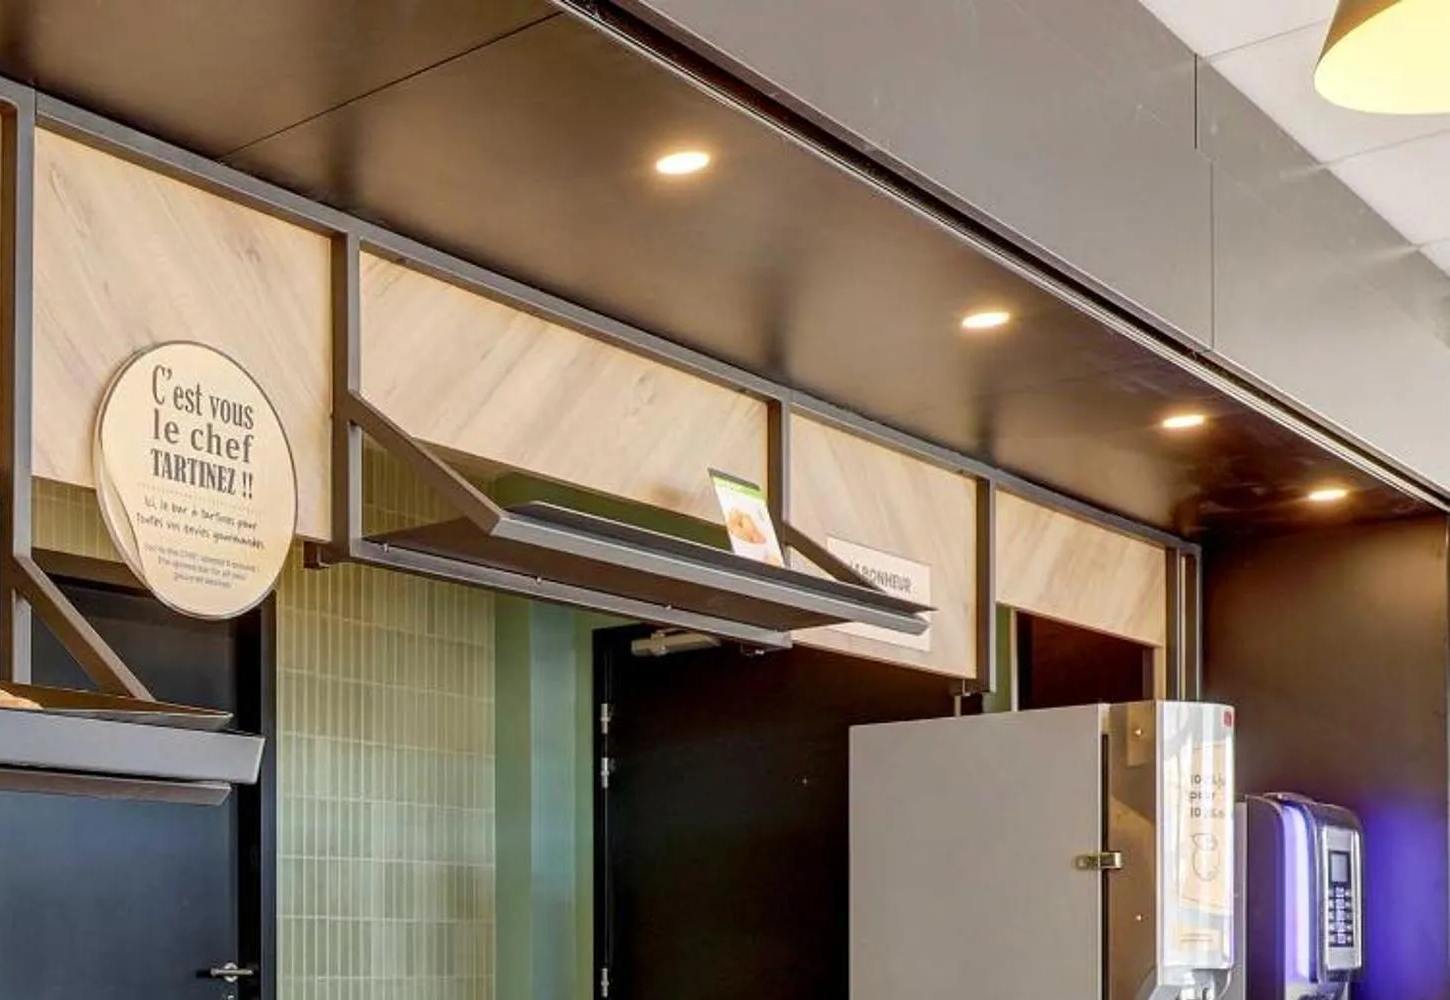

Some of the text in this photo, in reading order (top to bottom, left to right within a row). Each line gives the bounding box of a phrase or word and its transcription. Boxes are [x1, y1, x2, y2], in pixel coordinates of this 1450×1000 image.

[152, 364, 254, 430] C'est vous
[153, 407, 254, 464] le chef
[150, 448, 237, 495] TARTINEZ
